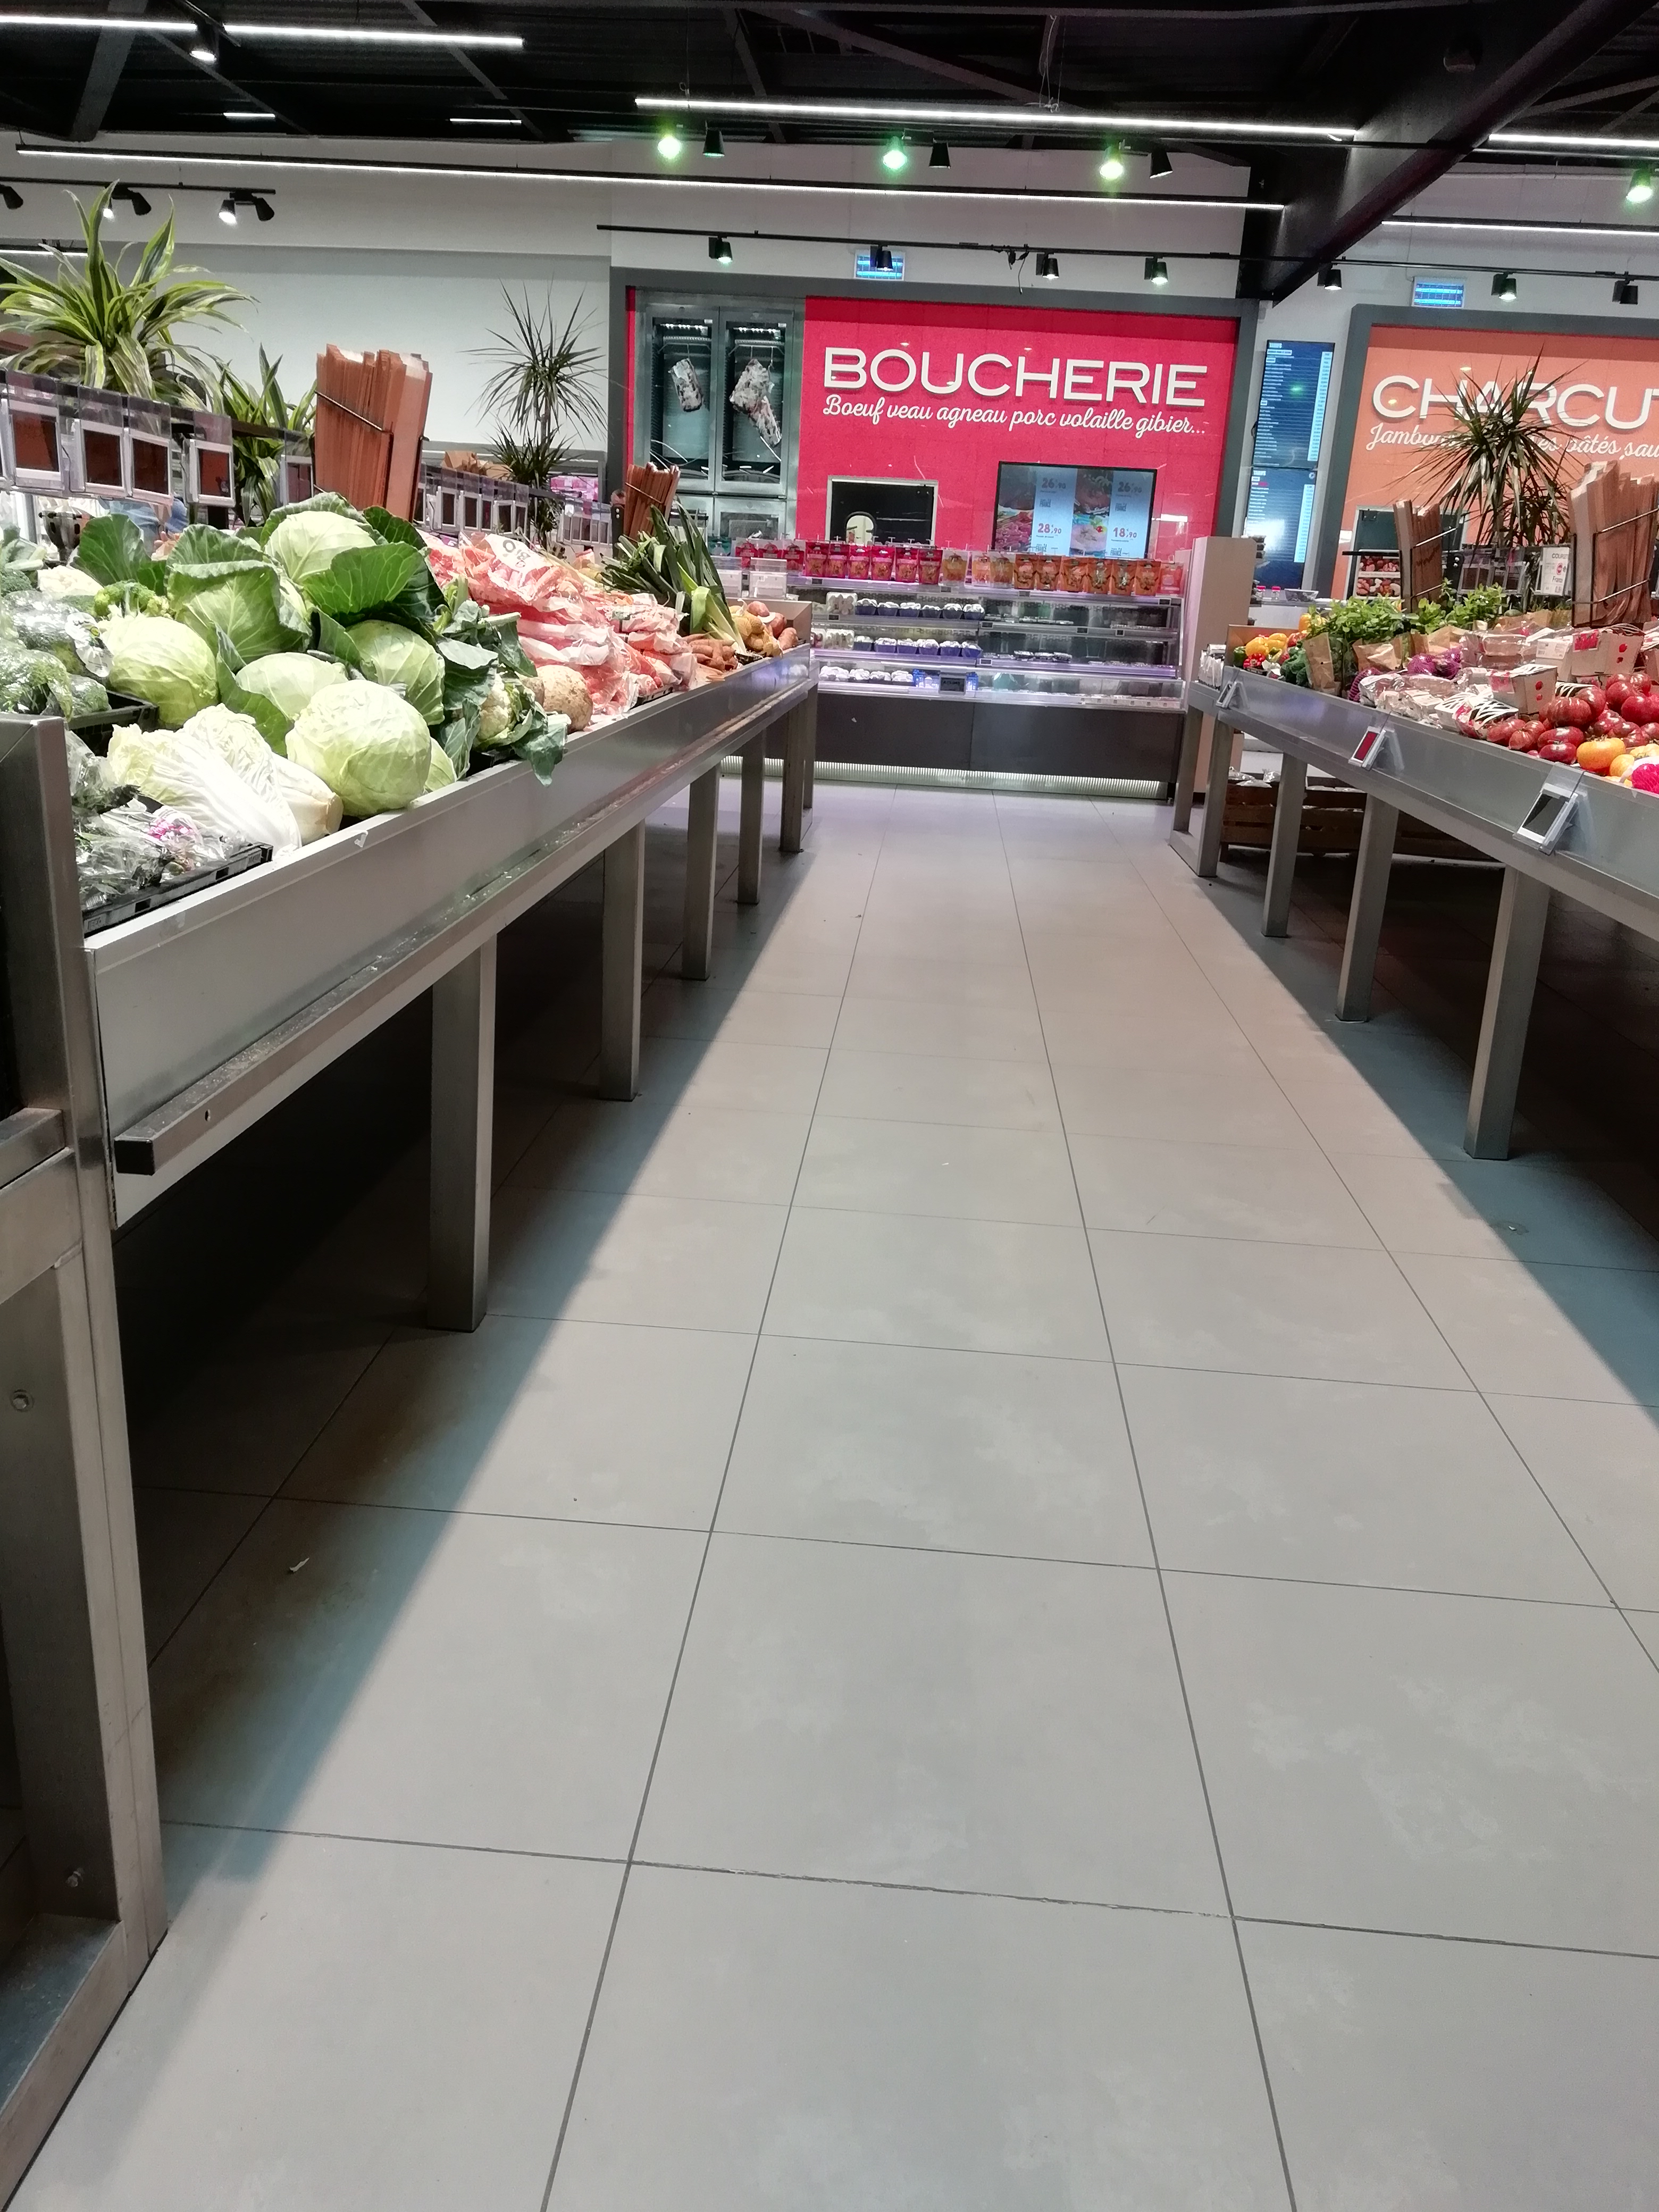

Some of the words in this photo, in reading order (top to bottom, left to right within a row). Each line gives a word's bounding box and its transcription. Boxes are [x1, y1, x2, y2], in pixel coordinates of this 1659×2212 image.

[824, 347, 1208, 406] BOUCHERIE
[1372, 375, 1659, 430] CHARCU
[823, 393, 886, 425] Boeuf
[886, 404, 933, 420] veau
[936, 406, 1008, 429] agneau
[1008, 408, 1057, 432] porc
[1059, 407, 1134, 431] volaille
[1135, 410, 1205, 439] gibier...
